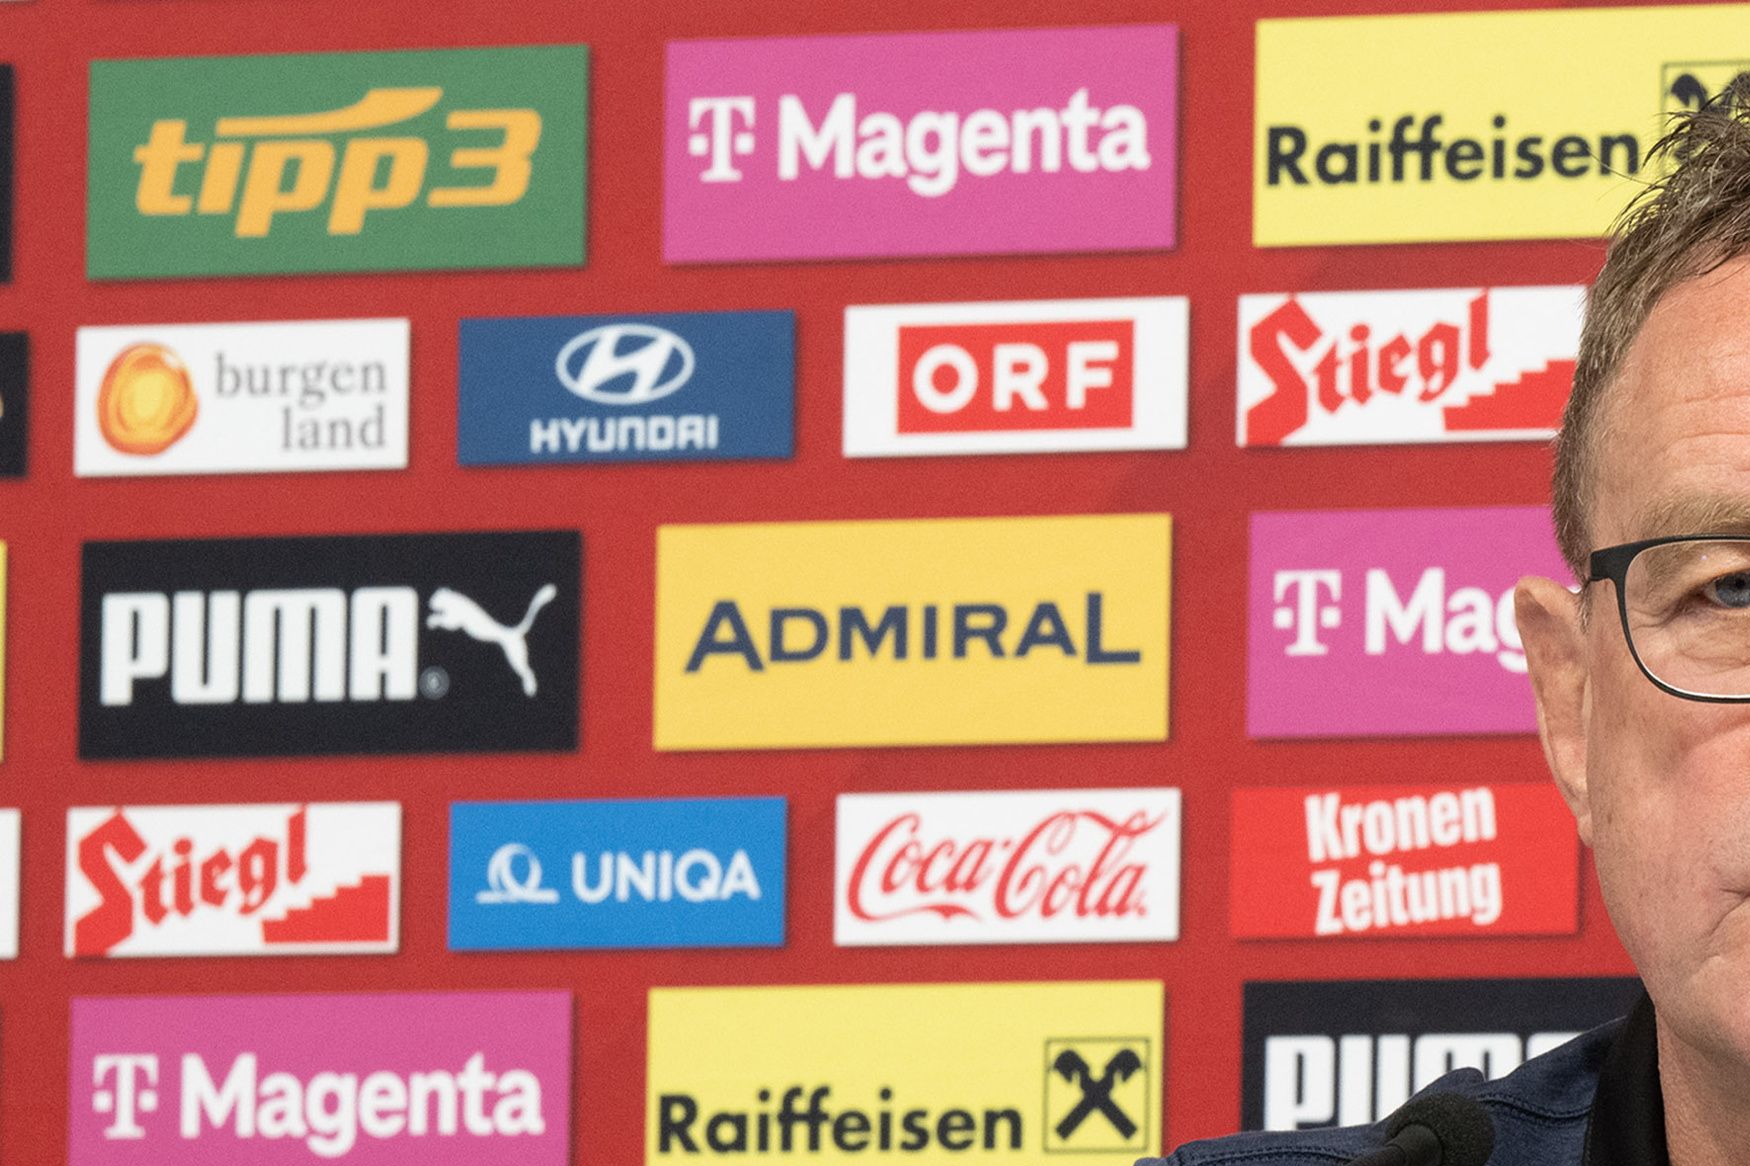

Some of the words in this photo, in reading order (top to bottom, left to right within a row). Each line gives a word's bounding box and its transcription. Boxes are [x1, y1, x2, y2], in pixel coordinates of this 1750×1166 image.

[134, 86, 543, 237] tipp3
[777, 86, 1150, 198] Magenta
[1266, 116, 1638, 187] Raiffeisen
[214, 353, 387, 408] burgen
[913, 340, 1120, 413] ORF
[1246, 288, 1490, 449] Stiegl
[280, 406, 387, 452] land
[530, 415, 718, 454] HYUNDAI
[100, 587, 419, 707] PUMA
[683, 591, 1141, 673] ADMIRAL
[1304, 787, 1497, 864] Kronen
[73, 803, 308, 958] Stiegl
[571, 847, 763, 904] UNIQA
[846, 807, 1170, 923] Coca-Cola
[1311, 859, 1503, 936] Zeitung
[179, 1050, 545, 1159] Magenta
[657, 1085, 1023, 1156] Raiffeisen
